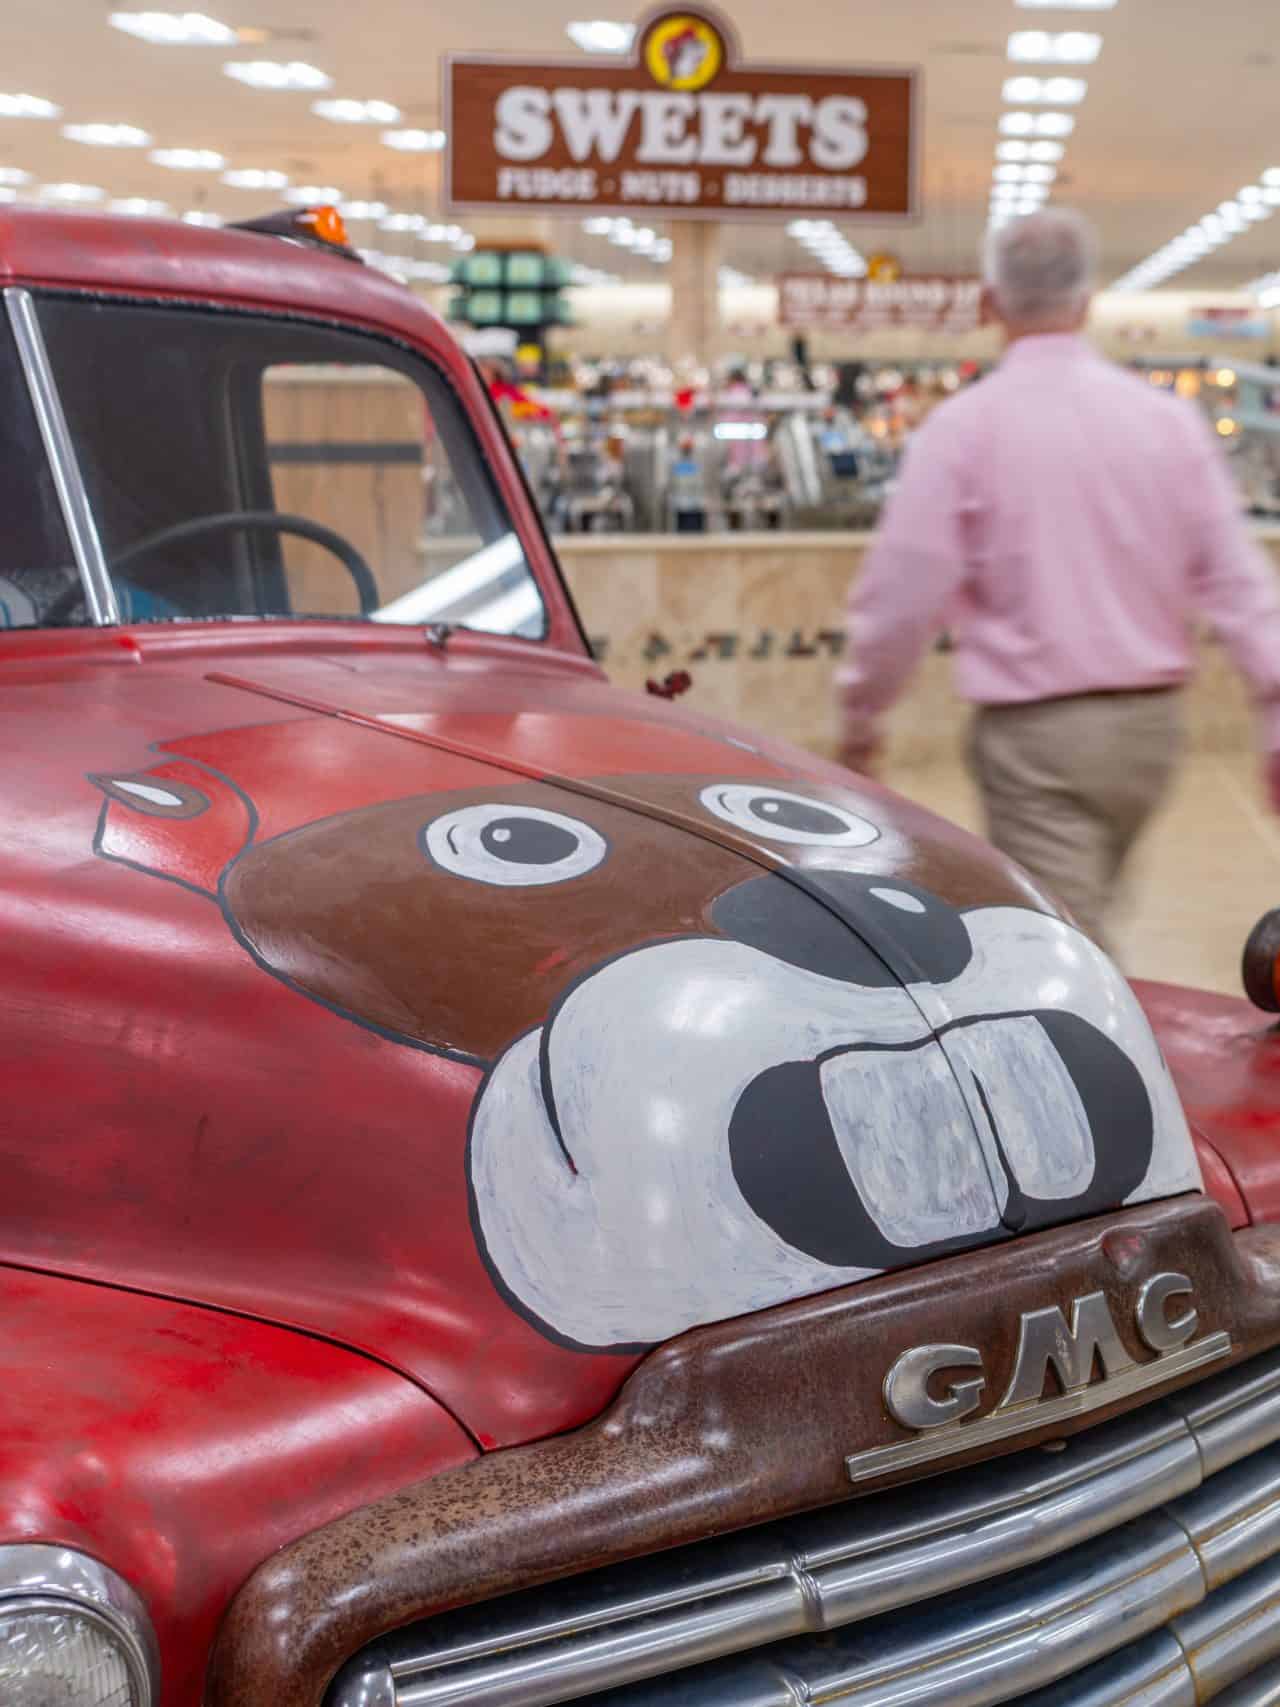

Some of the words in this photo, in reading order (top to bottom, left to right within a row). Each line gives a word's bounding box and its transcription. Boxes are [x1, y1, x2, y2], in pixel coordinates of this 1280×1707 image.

[494, 85, 869, 169] SWEETS
[497, 168, 598, 200] FUDGE
[620, 171, 701, 204] NUTS
[724, 174, 867, 208] DESSERTS
[884, 1272, 1198, 1430] GMC
